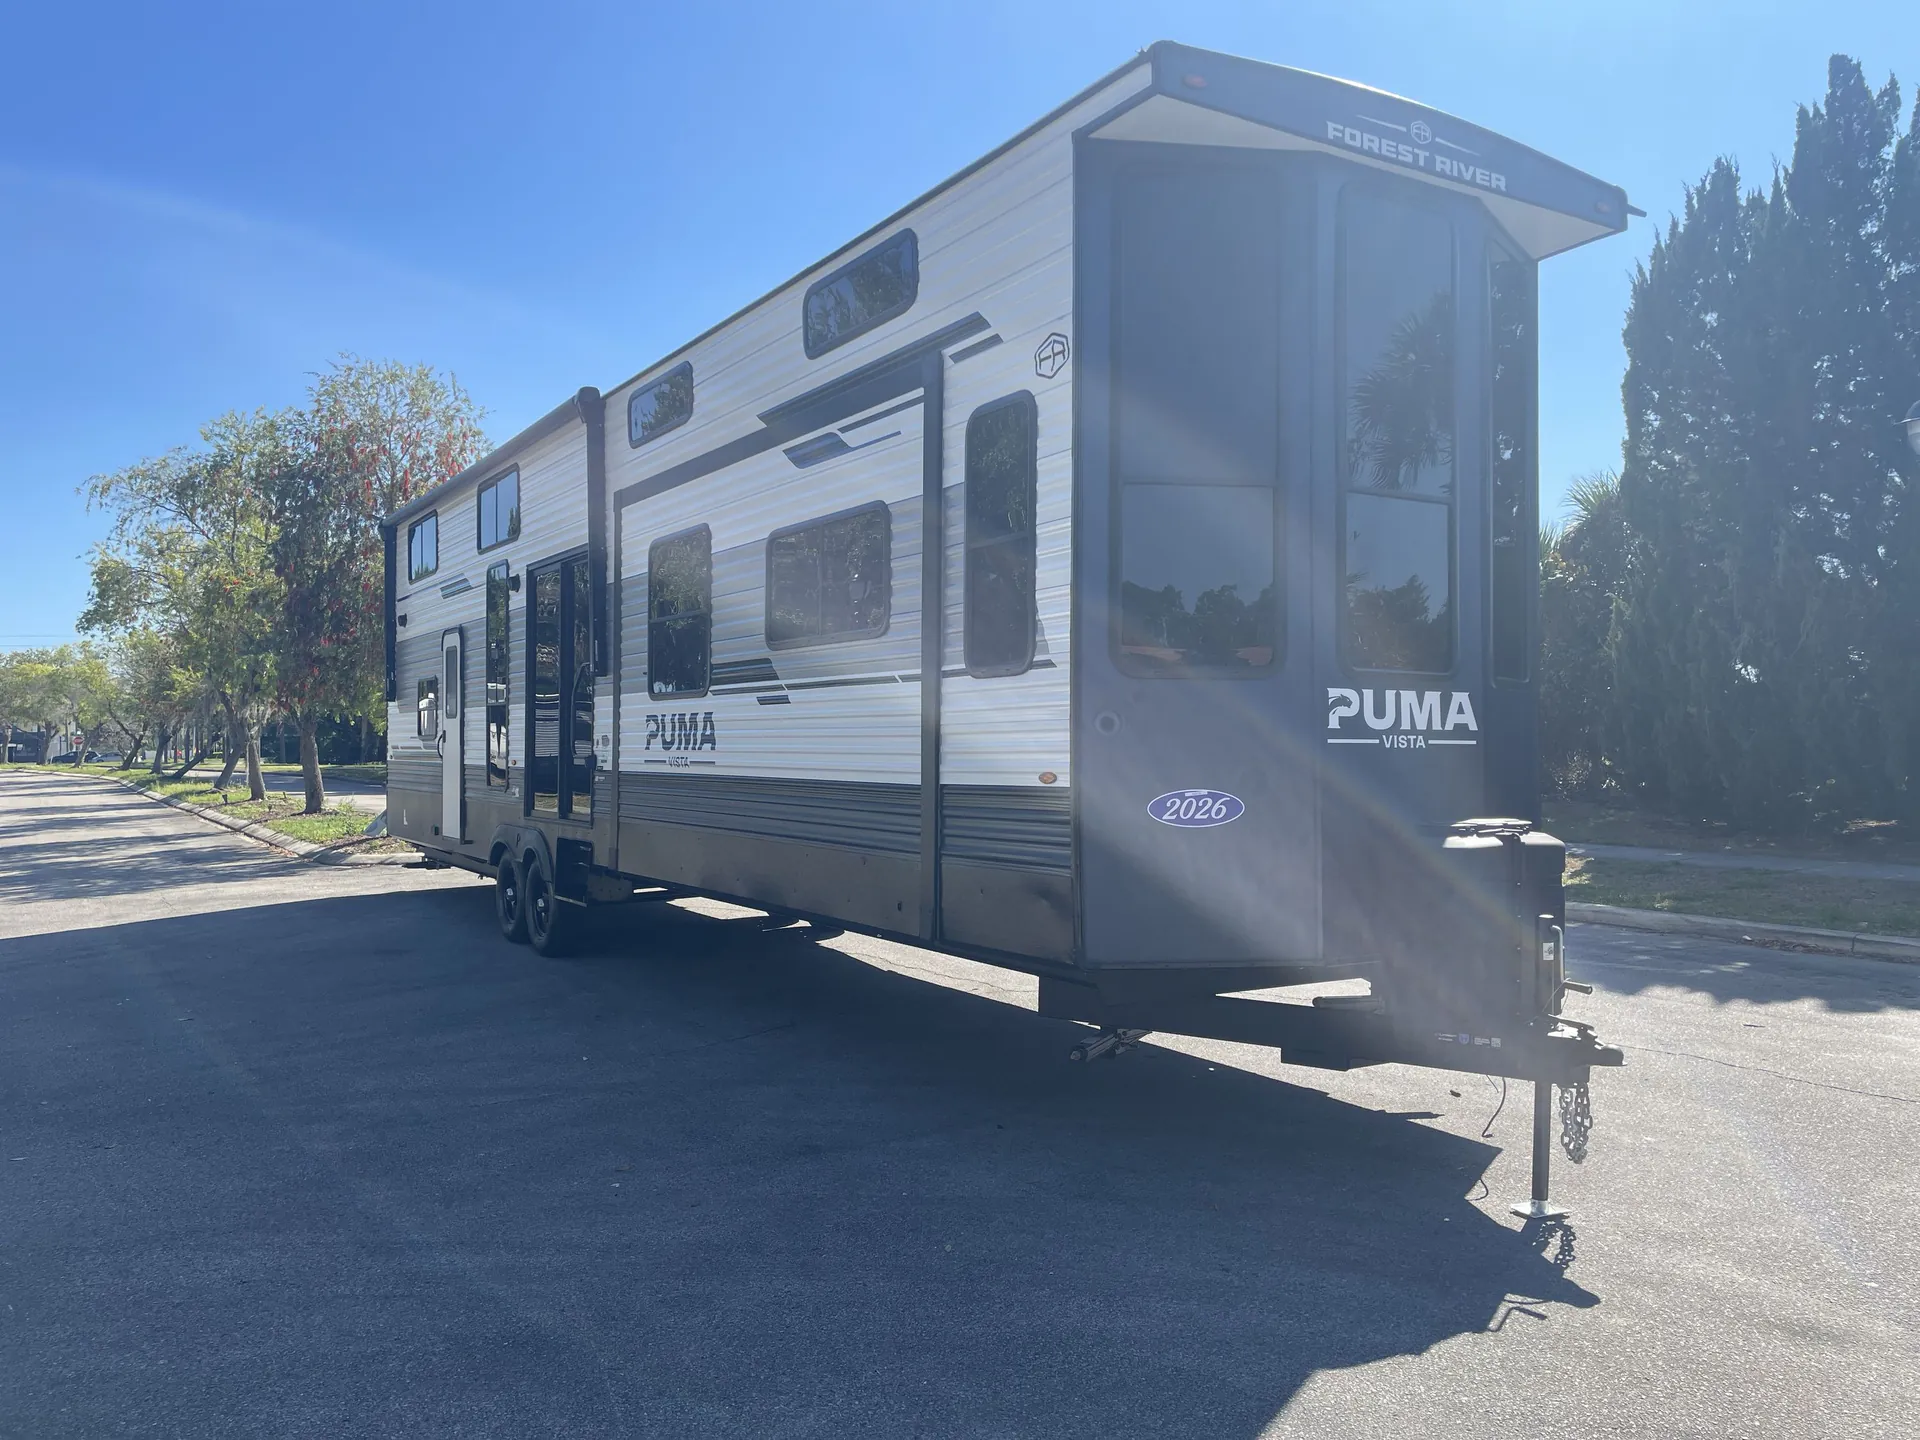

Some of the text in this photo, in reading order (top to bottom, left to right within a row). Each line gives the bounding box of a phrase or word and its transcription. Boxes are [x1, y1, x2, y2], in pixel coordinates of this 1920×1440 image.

[1326, 121, 1507, 191] FOREST RIVER
[1327, 687, 1478, 731] PUMA
[645, 712, 716, 751] PUMA
[1382, 735, 1426, 748] VISTA
[668, 756, 690, 768] VISTA
[1162, 797, 1230, 820] 2026
